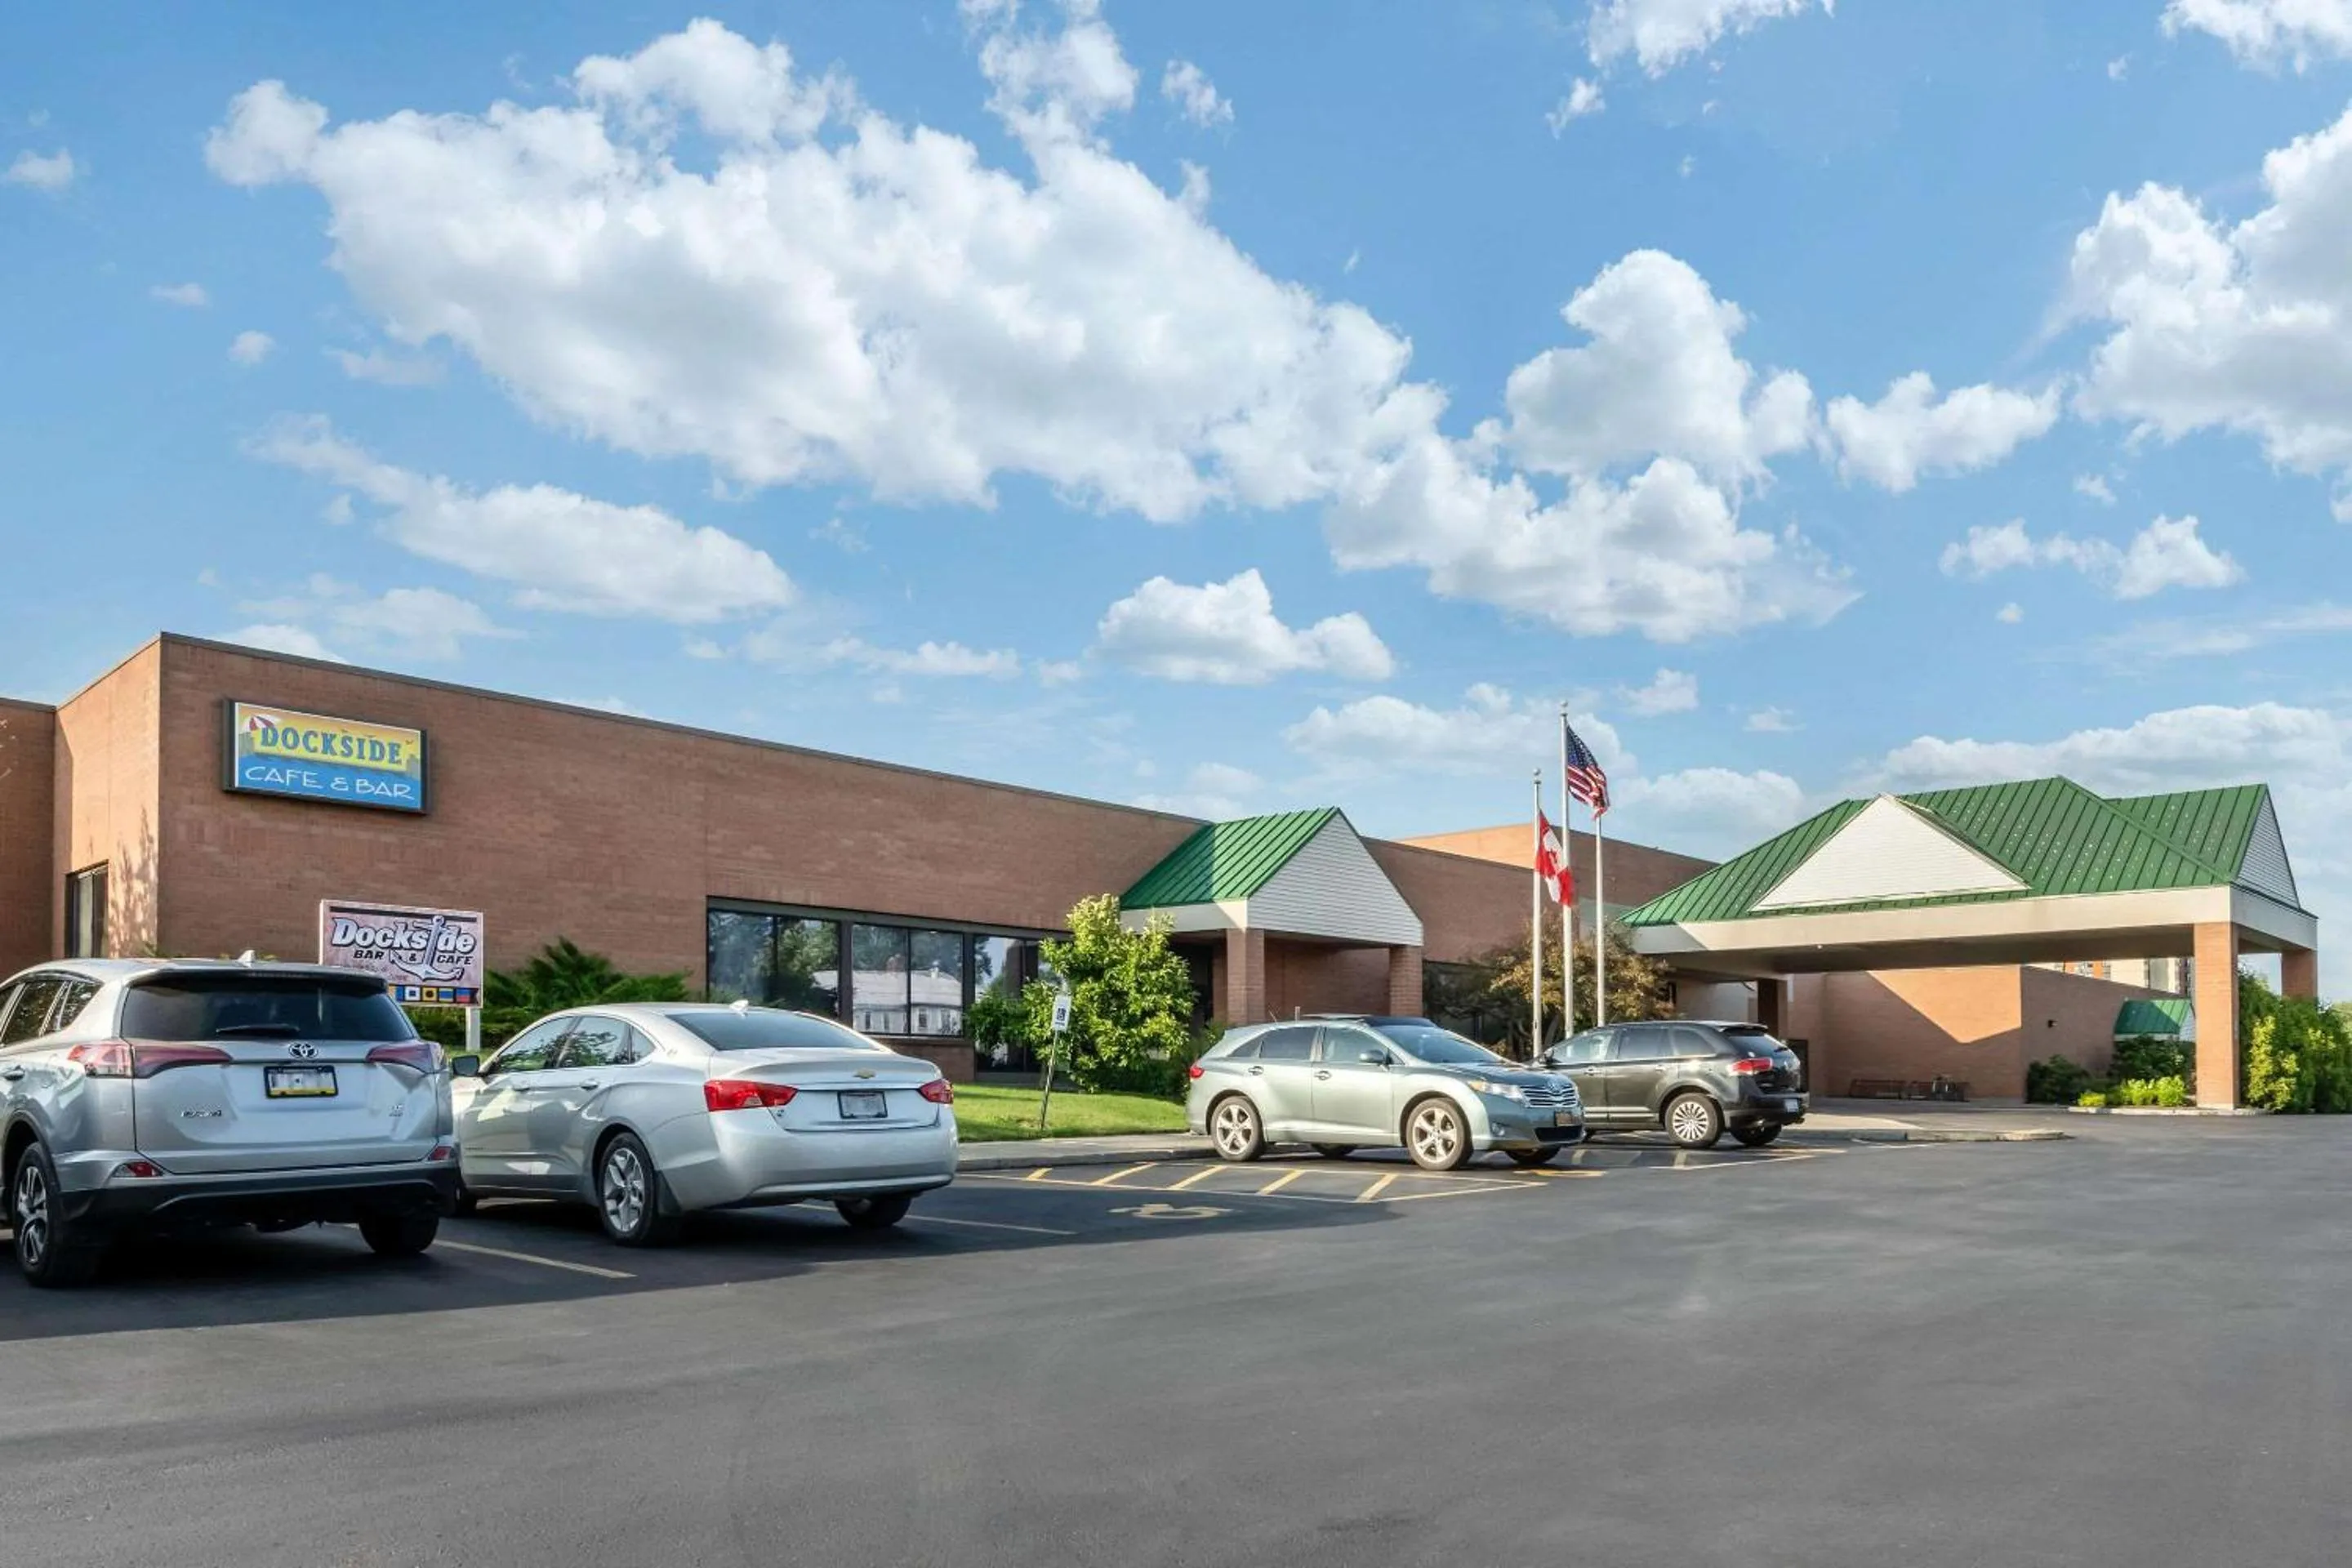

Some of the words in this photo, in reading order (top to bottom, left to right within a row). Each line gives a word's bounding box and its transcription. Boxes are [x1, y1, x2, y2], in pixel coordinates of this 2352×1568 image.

[260, 725, 403, 764] DOCKSIDE
[245, 766, 323, 789] CAFE
[330, 777, 349, 791] &
[355, 778, 415, 800] BAR
[353, 949, 385, 960] BAR
[408, 952, 417, 962] &
[437, 954, 474, 965] CAFE
